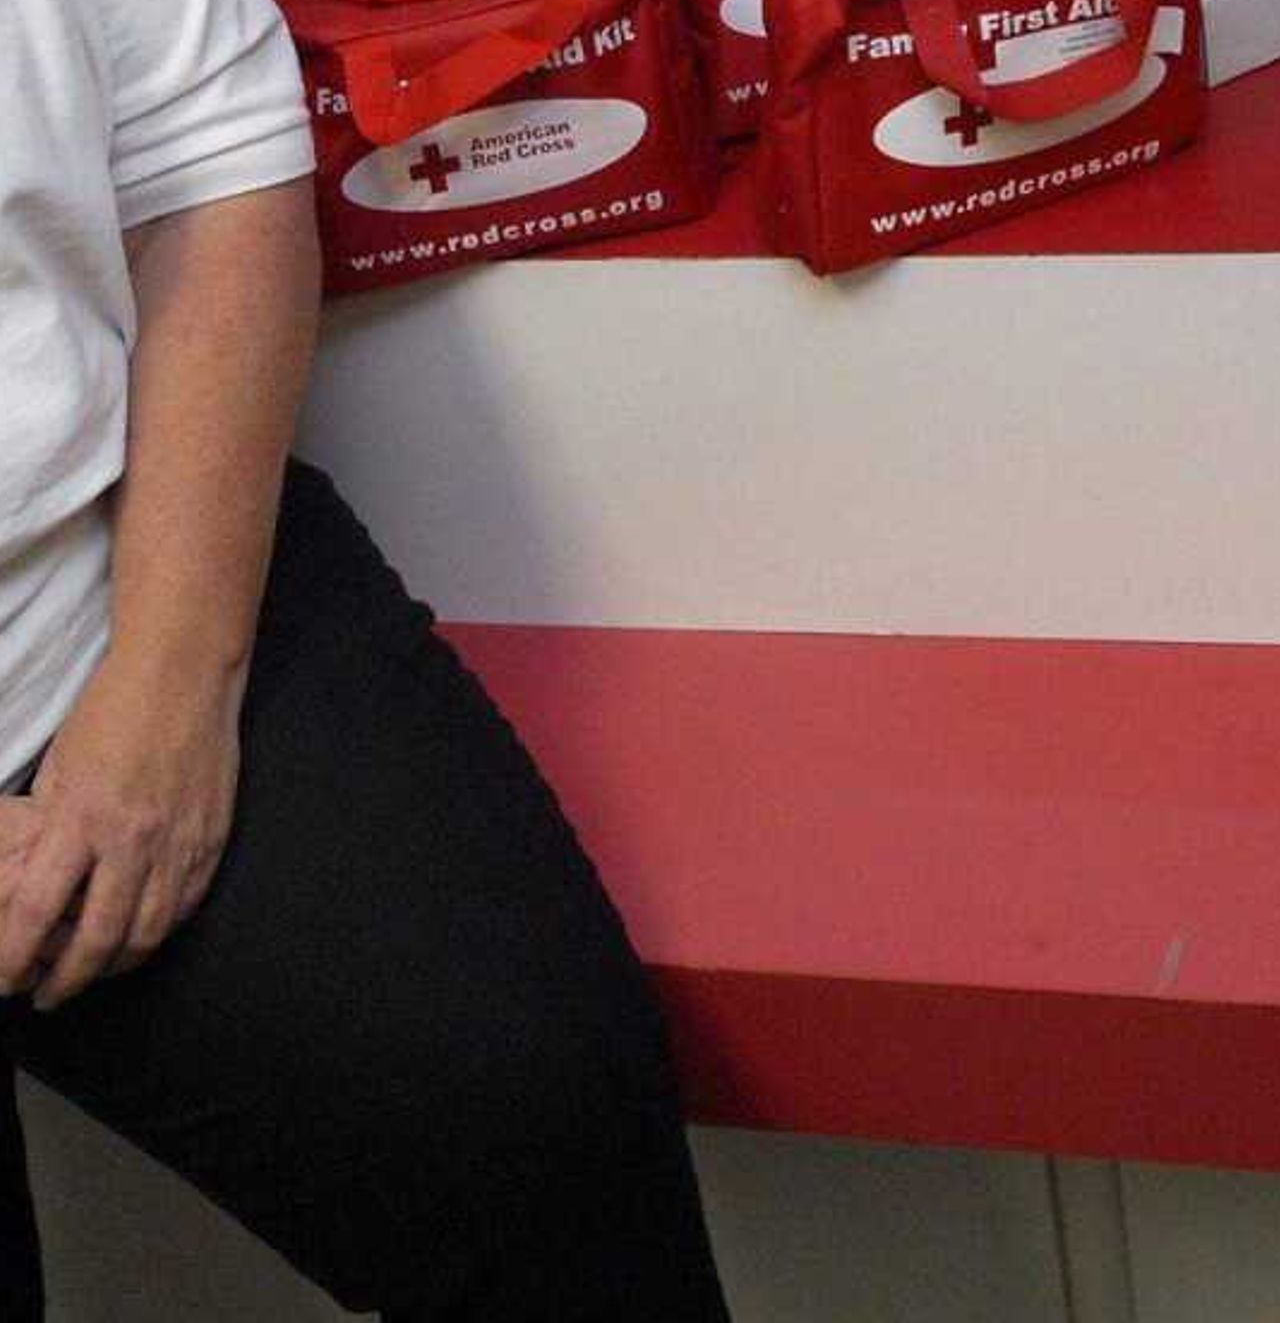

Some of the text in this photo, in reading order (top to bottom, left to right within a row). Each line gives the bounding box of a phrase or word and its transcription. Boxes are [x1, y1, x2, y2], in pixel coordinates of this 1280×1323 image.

[593, 17, 637, 58] Kit
[978, 0, 1061, 43] First
[470, 121, 571, 155] American
[472, 135, 575, 170] Red Cross
[870, 138, 1161, 234] www.redcross.org
[351, 187, 665, 271] www.redcross.org
